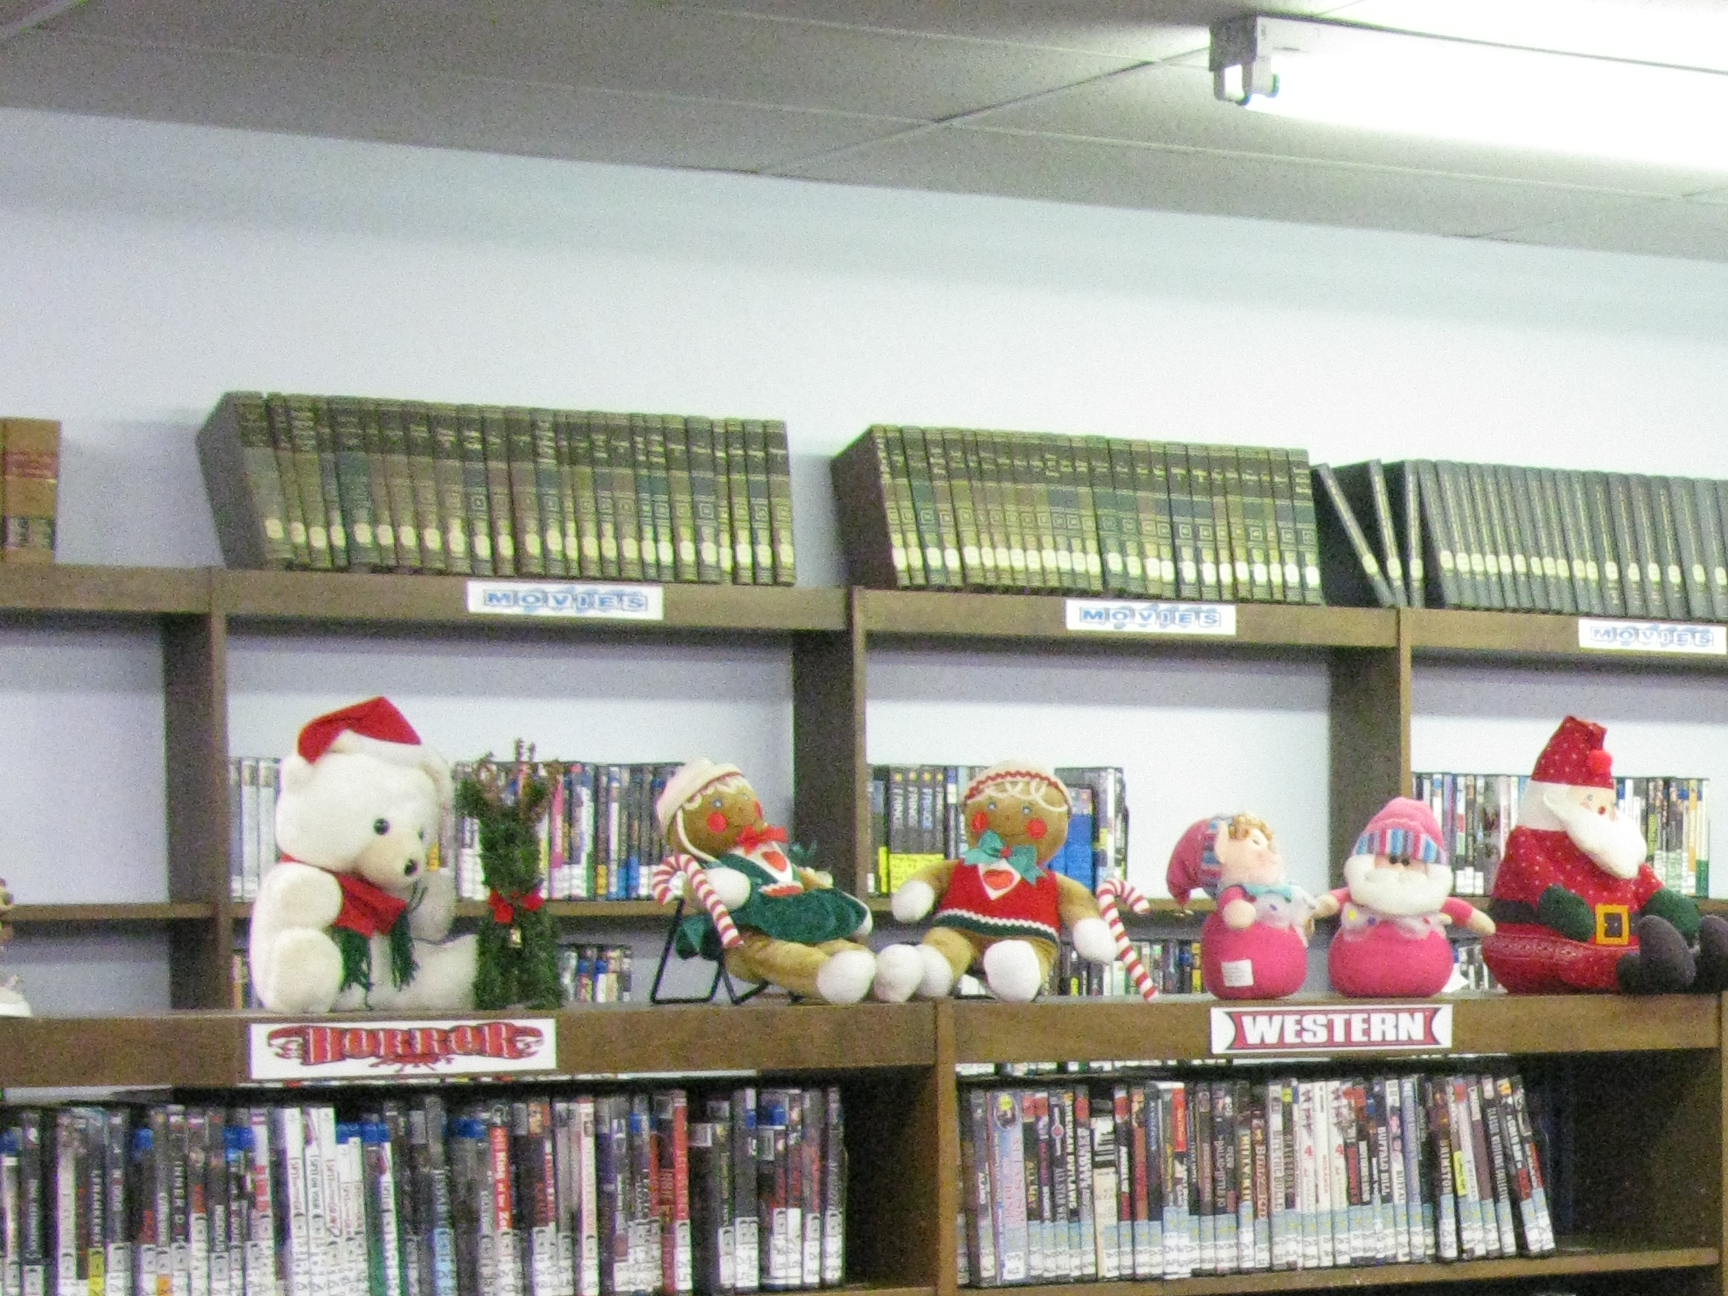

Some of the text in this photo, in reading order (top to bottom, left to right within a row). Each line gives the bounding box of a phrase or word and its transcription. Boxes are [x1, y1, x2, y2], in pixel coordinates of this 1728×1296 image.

[485, 591, 647, 610] MOVIES
[1081, 607, 1221, 625] MOVIES
[300, 1022, 515, 1066] HORROR
[1240, 1012, 1425, 1045] WESTERN
[1377, 1126, 1391, 1196] BUFFALO BILL
